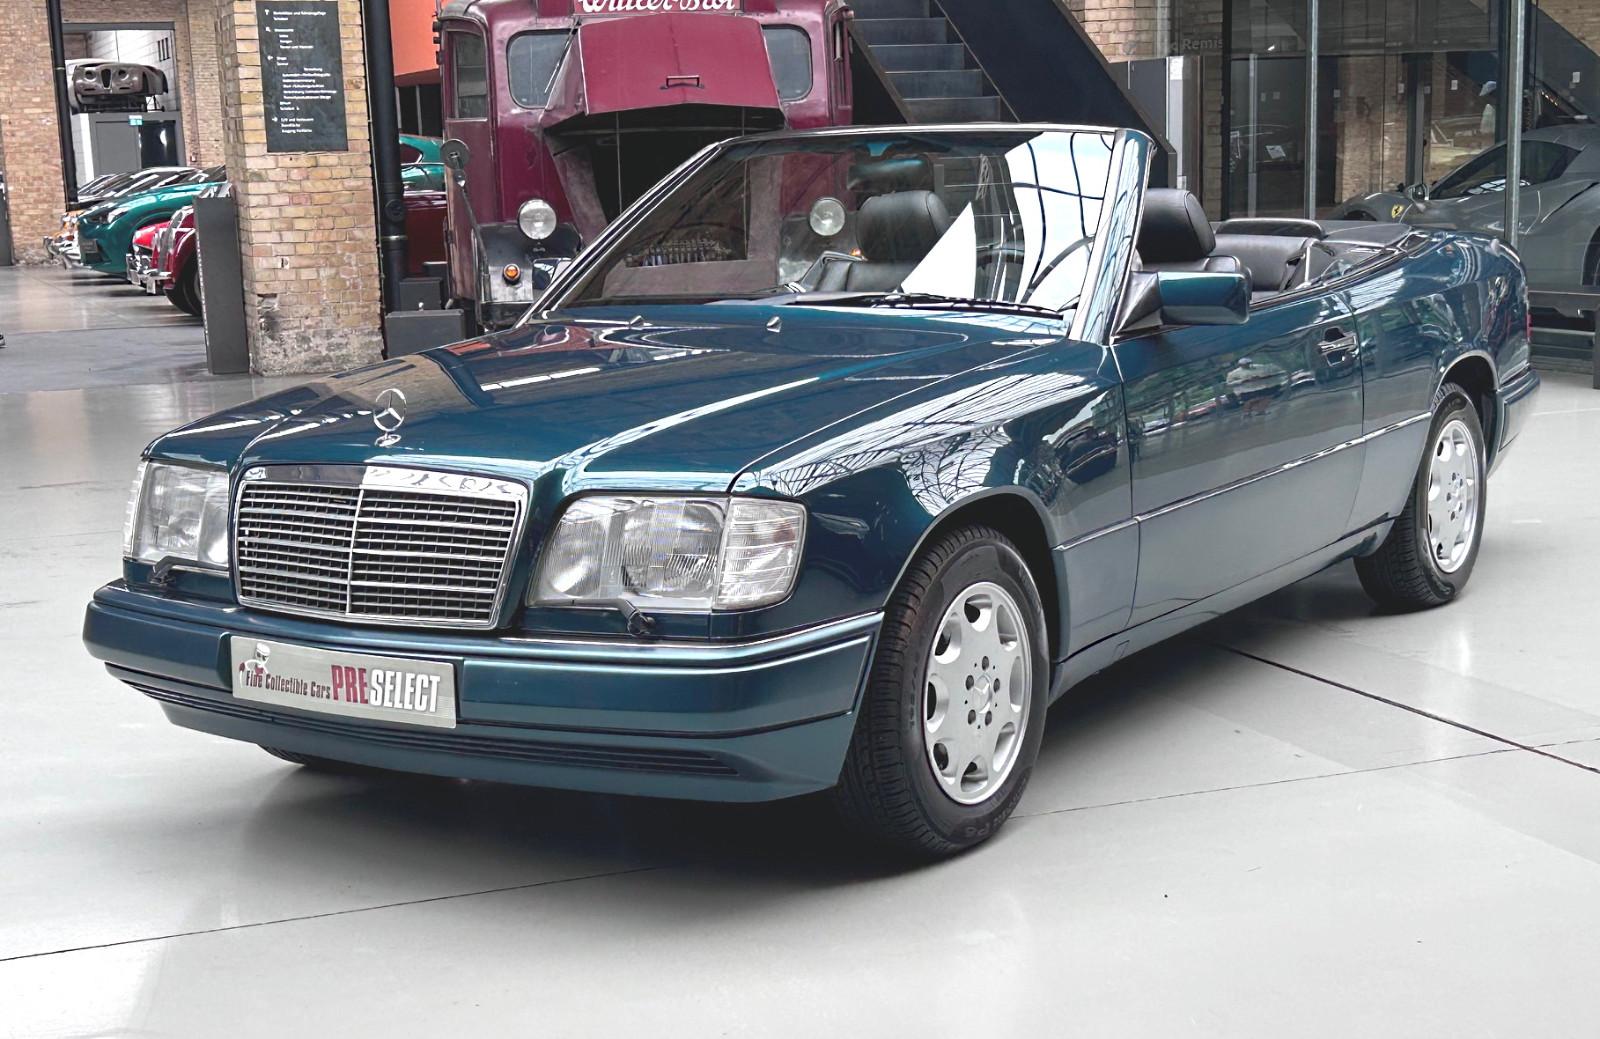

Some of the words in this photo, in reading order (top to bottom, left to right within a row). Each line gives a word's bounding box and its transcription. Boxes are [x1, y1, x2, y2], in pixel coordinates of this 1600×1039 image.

[246, 670, 263, 688] Fine
[265, 673, 308, 696] Collectible
[310, 681, 331, 699] Cars
